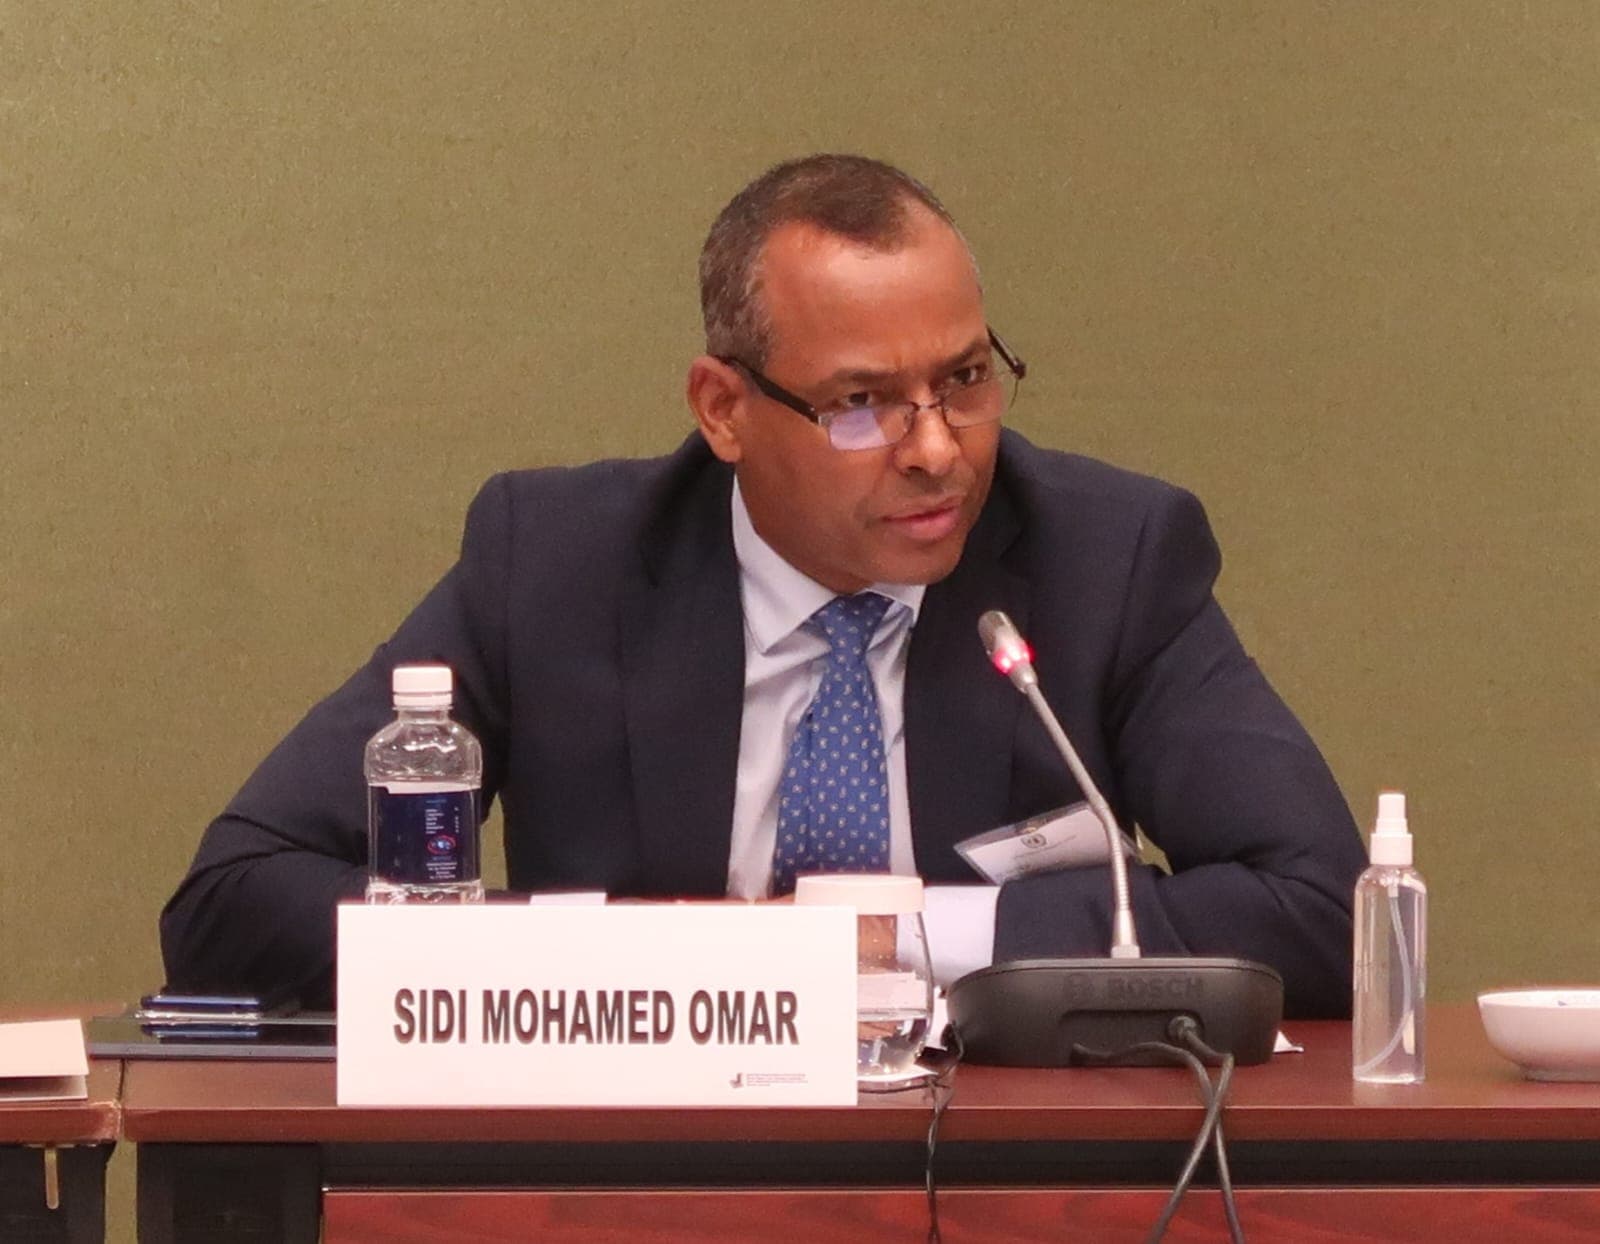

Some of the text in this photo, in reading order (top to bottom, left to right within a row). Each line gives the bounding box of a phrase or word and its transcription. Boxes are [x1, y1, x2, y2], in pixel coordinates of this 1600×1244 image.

[1108, 977, 1204, 999] BOSCH
[393, 988, 799, 1044] SIDI MOHAMED OMAR
